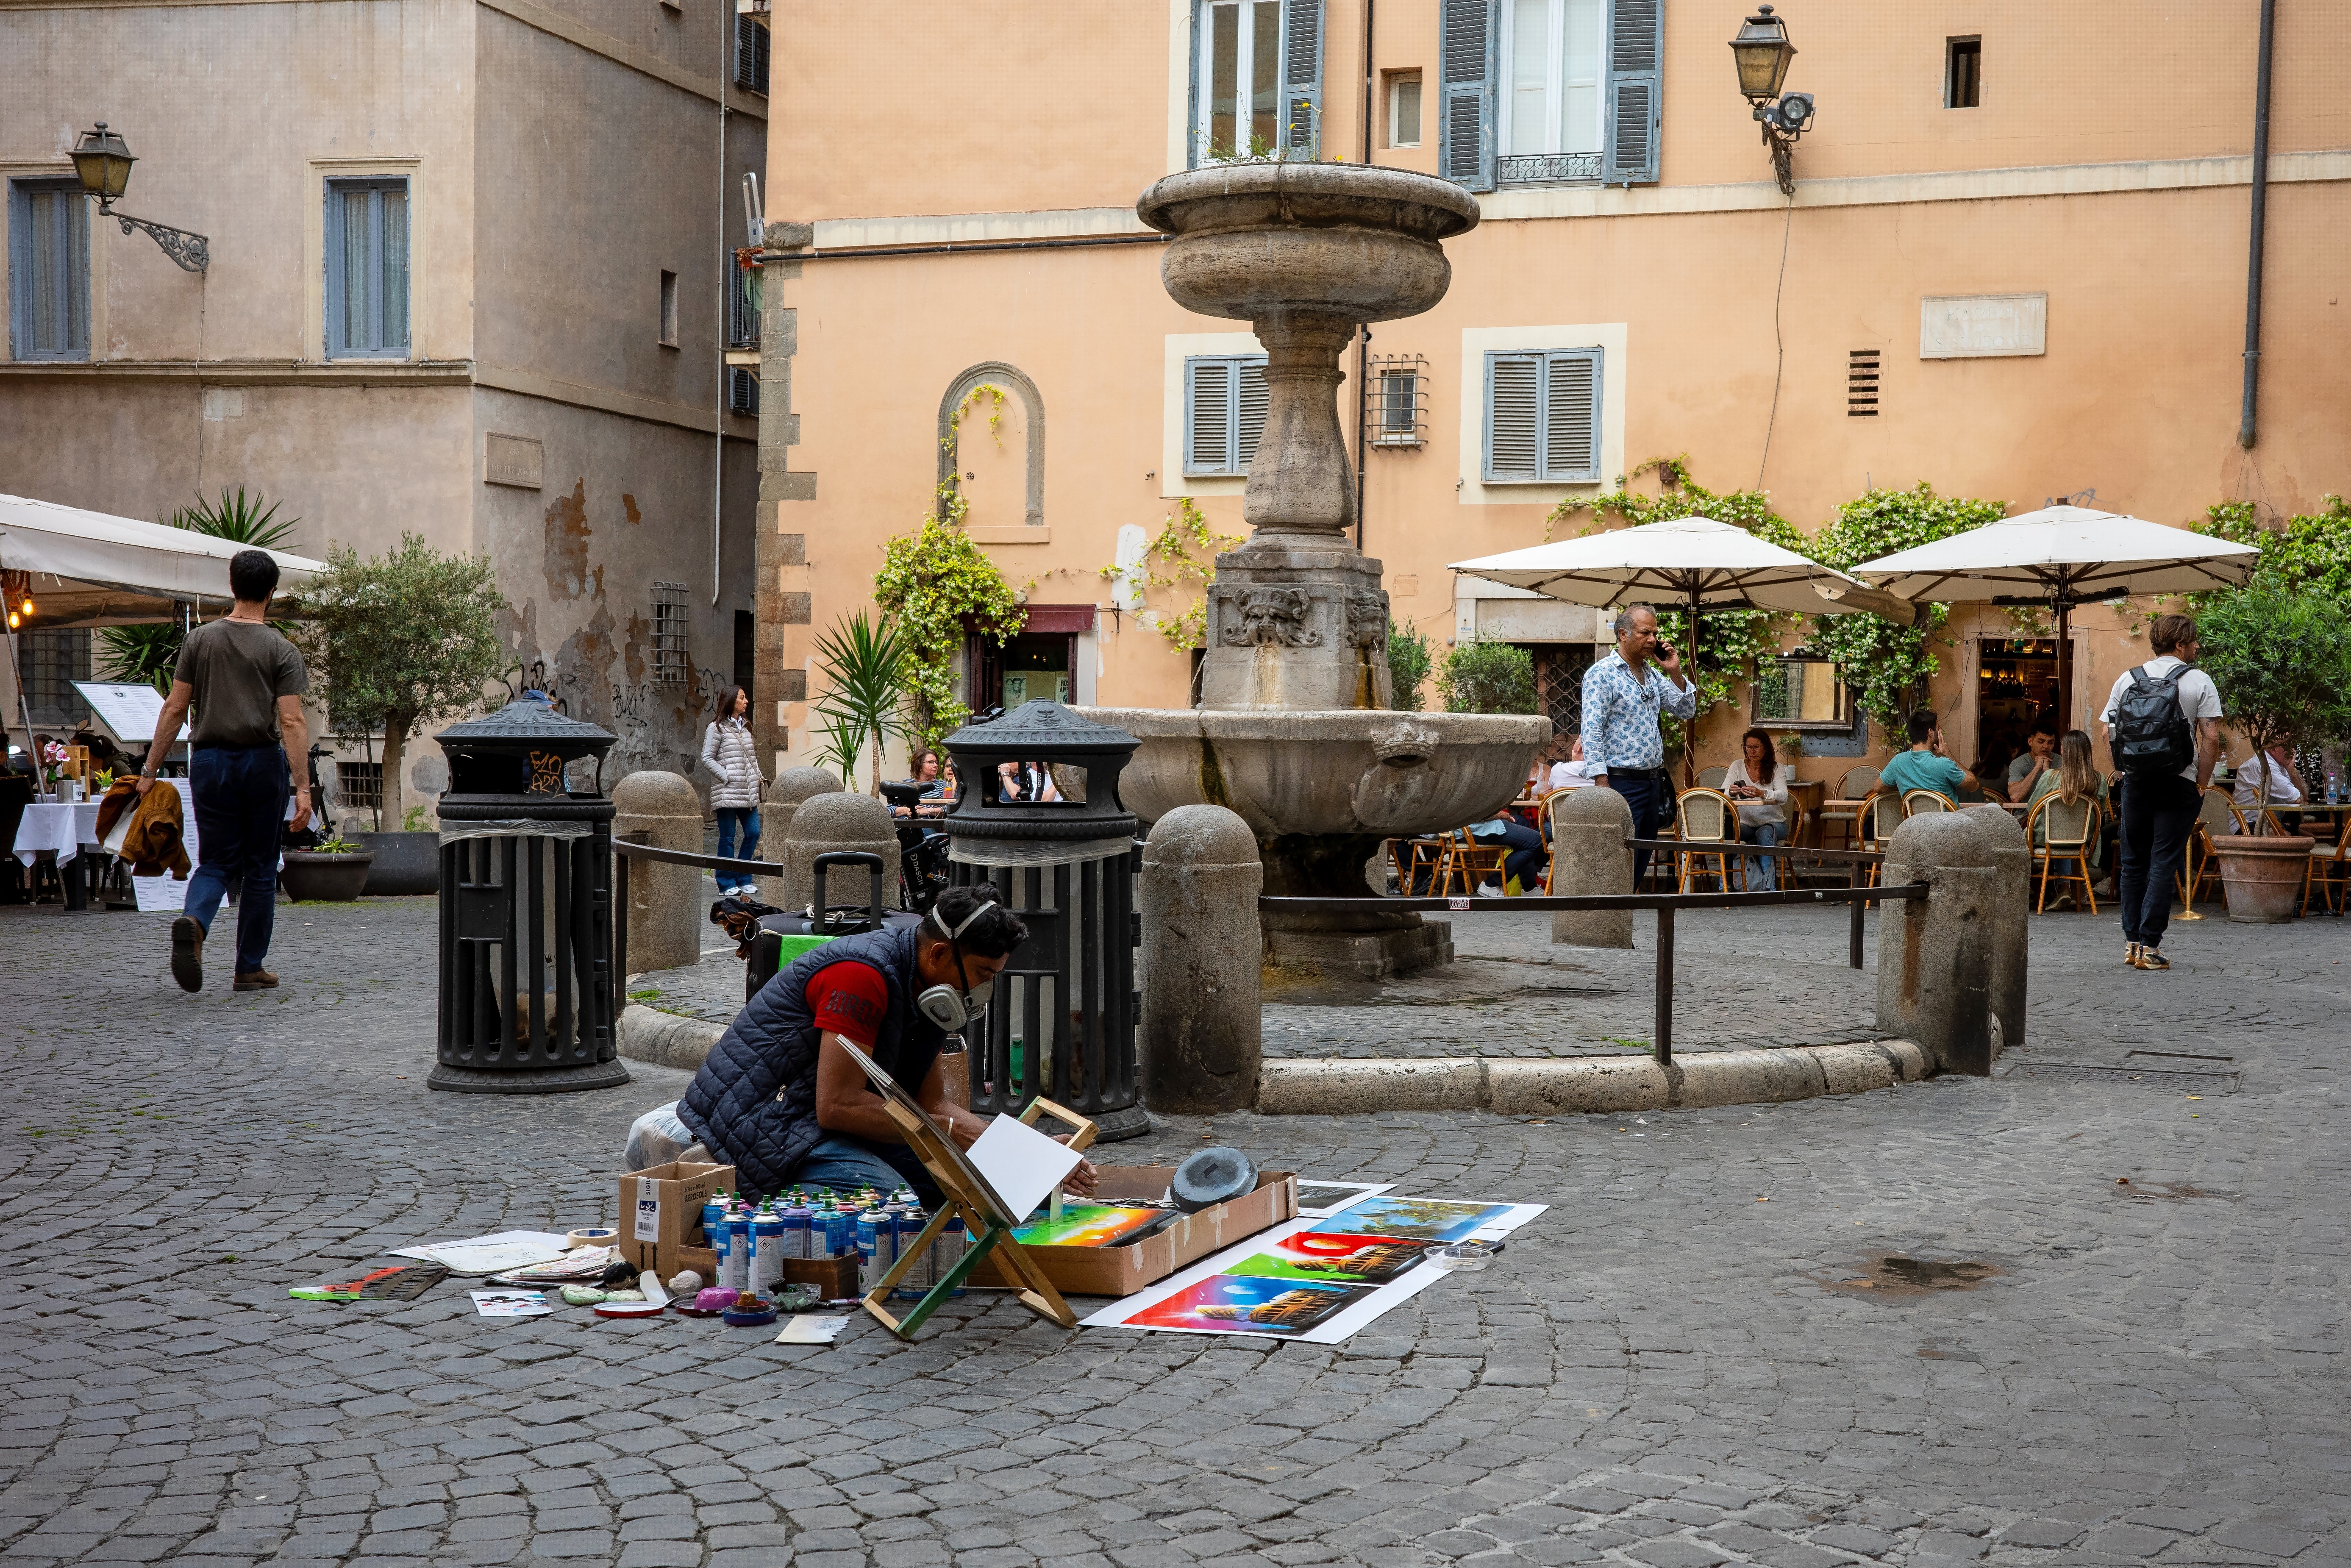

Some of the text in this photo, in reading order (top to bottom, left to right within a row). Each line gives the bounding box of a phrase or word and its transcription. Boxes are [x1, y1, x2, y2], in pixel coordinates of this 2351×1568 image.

[1951, 334, 2030, 349] SIMEONE
[509, 446, 521, 456] VIA
[913, 861, 924, 885] DASCH
[684, 1189, 707, 1203] AEROSOLS
